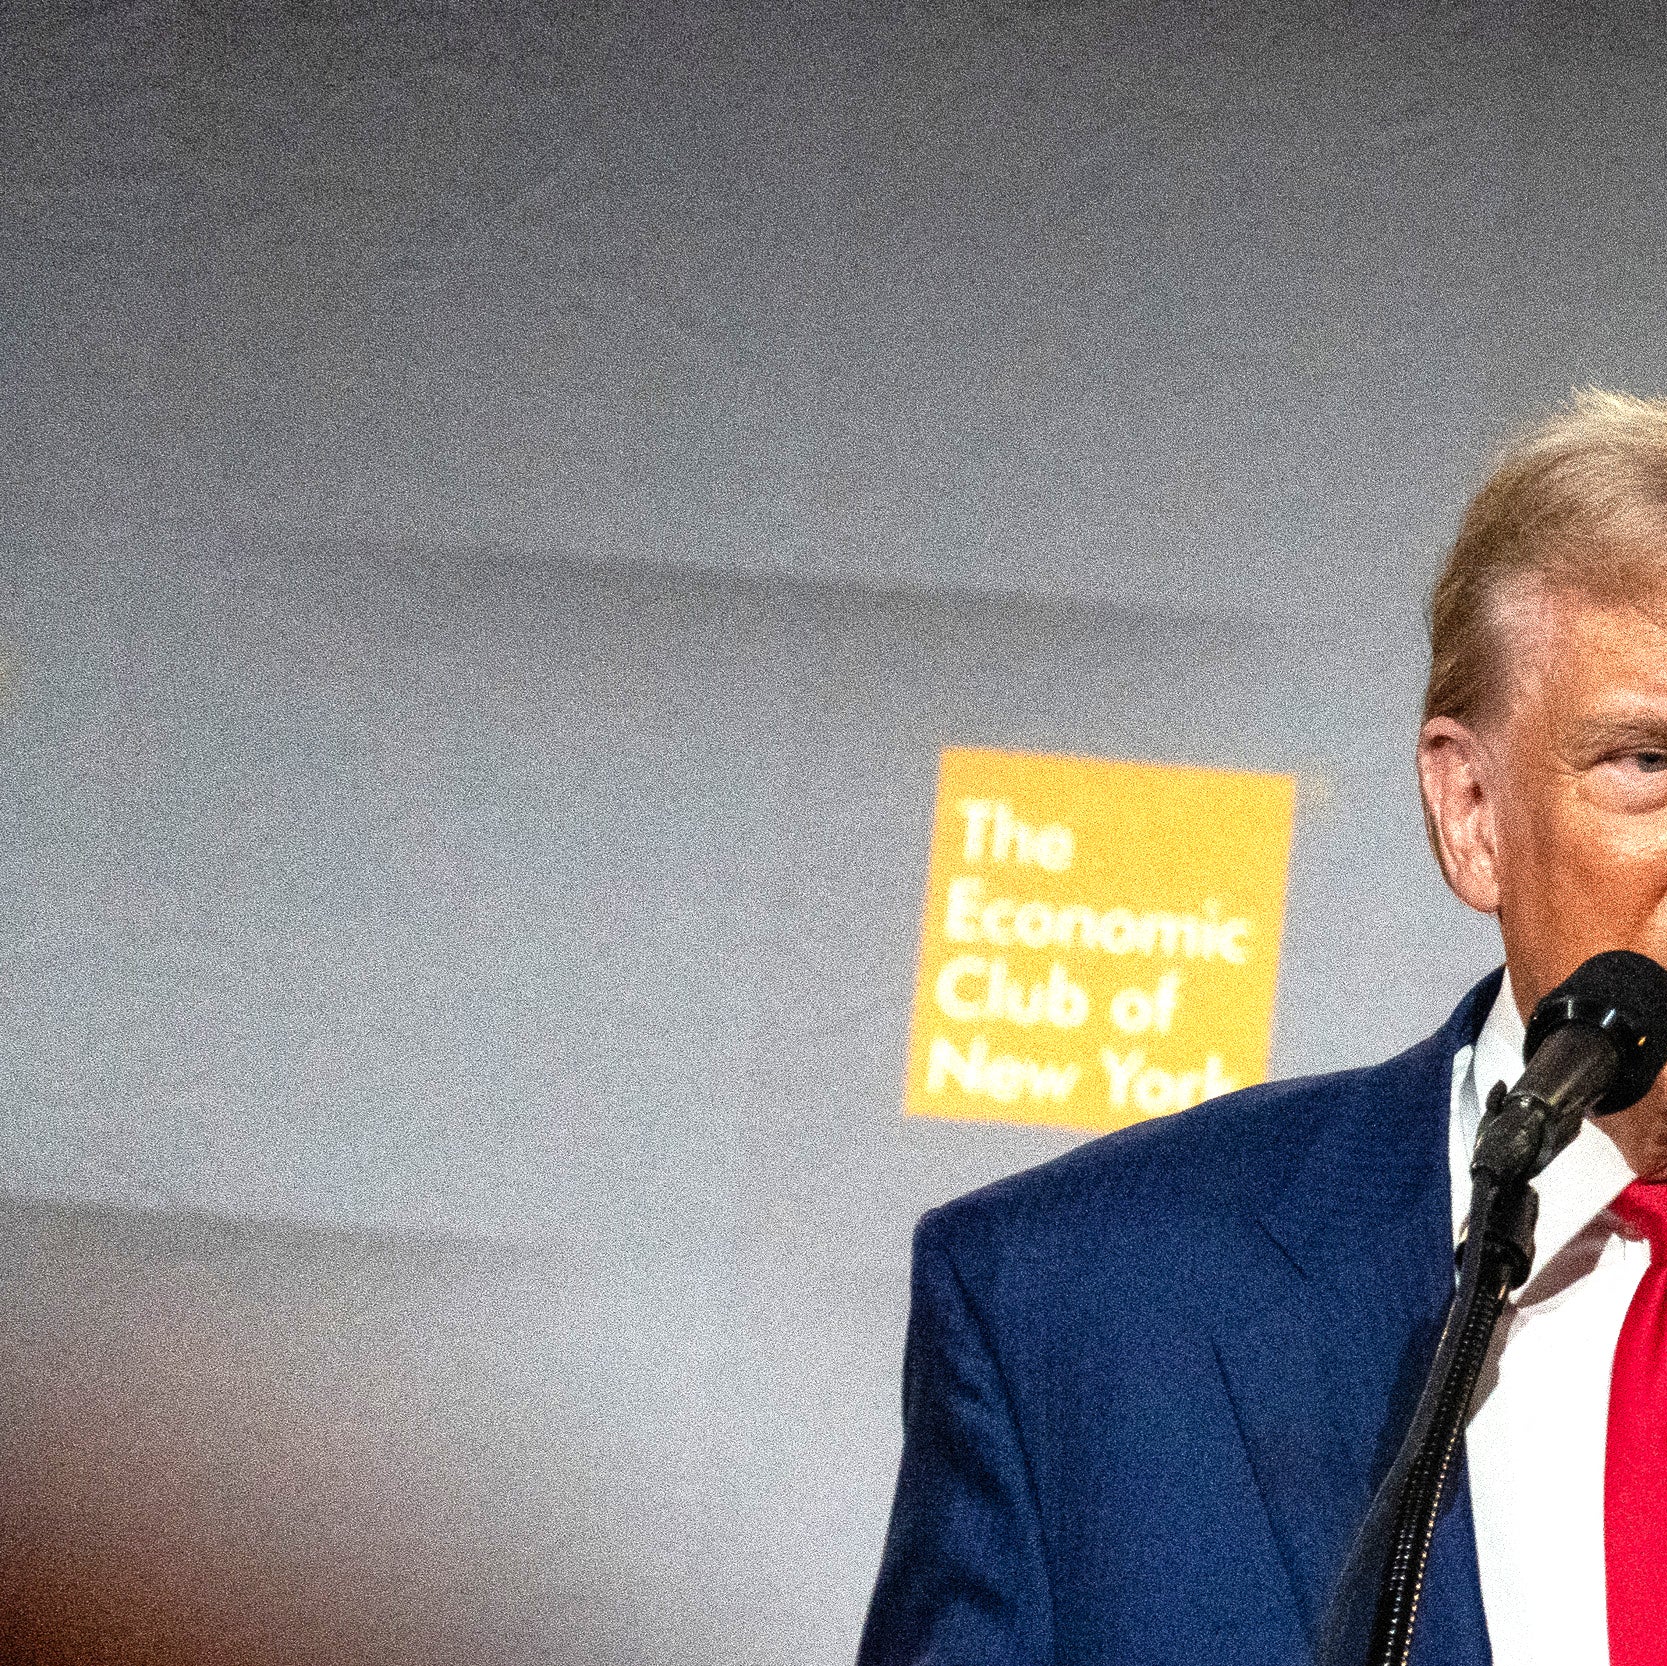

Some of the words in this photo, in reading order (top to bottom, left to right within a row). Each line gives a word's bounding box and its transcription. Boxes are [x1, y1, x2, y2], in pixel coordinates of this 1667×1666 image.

[957, 800, 1074, 872] The
[945, 877, 1252, 963] Economic
[935, 956, 1089, 1029] Club
[1111, 970, 1180, 1034] of
[927, 1037, 1080, 1104] New
